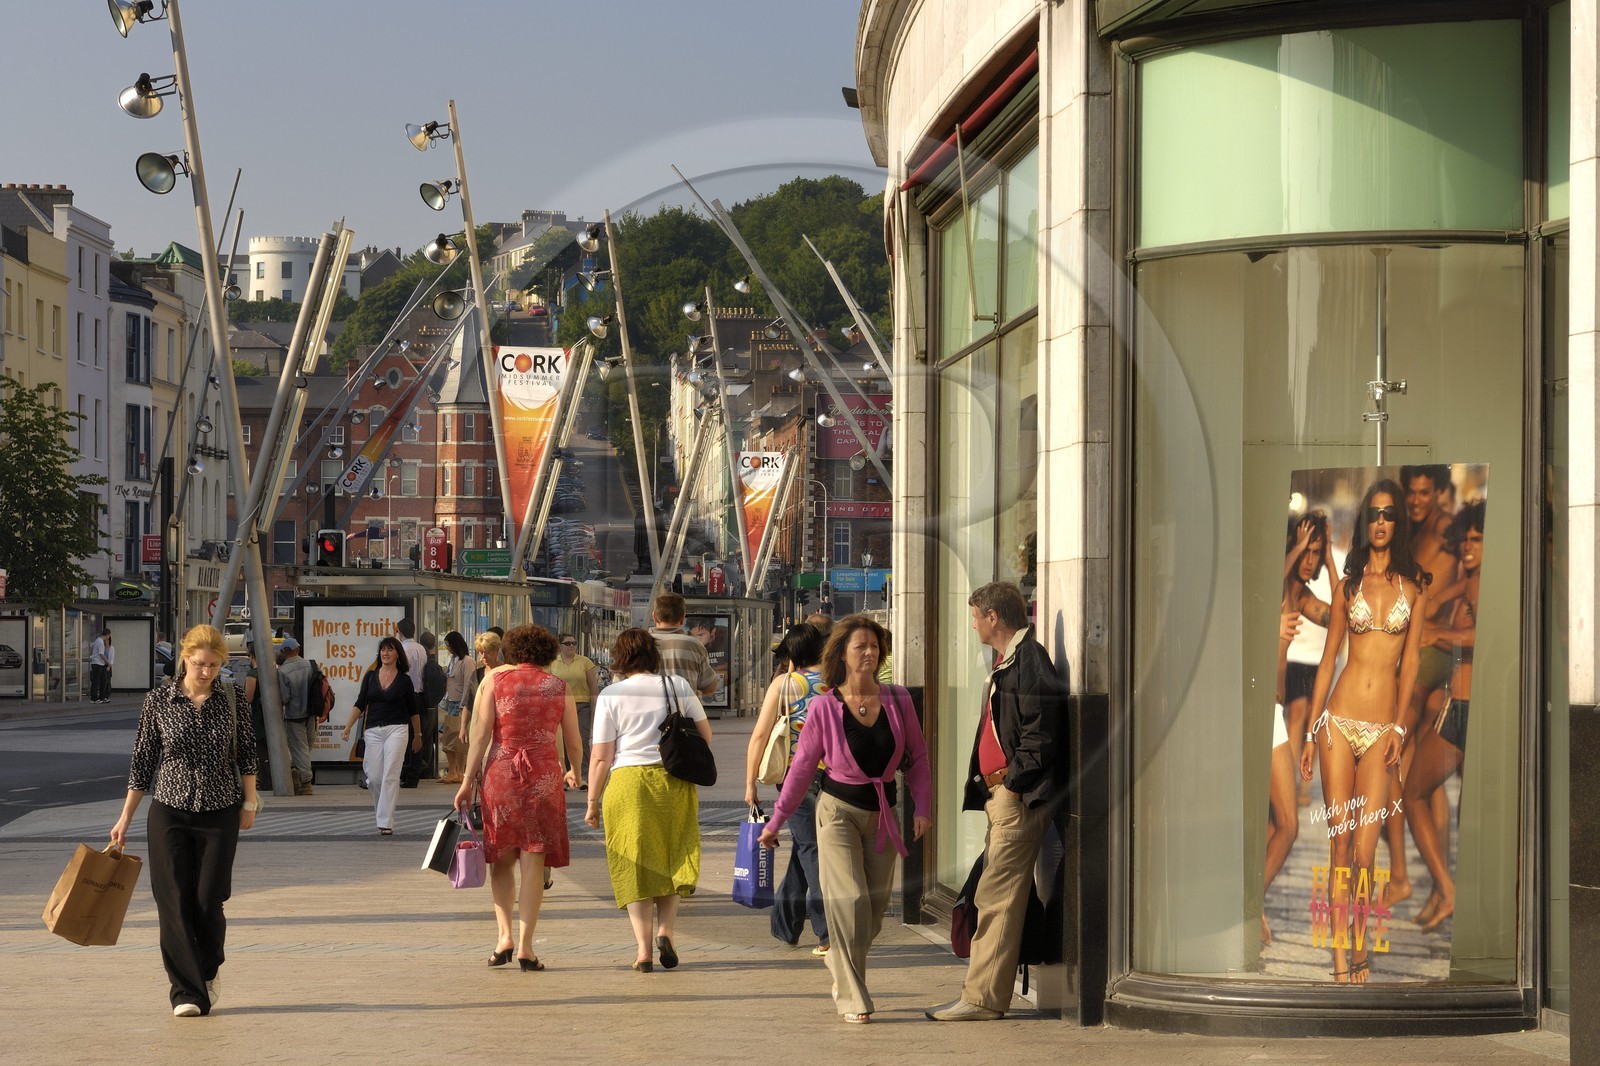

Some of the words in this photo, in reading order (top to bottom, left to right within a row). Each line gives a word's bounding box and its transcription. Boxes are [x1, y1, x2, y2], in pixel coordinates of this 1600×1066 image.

[501, 353, 561, 373] CORK
[741, 456, 780, 468] CORK
[430, 546, 437, 556] 8
[118, 588, 140, 596] schuh
[312, 619, 351, 637] More
[356, 618, 399, 637] fruity
[326, 640, 356, 659] less
[1310, 798, 1342, 825] Wish
[1342, 795, 1368, 823] you
[1327, 820, 1358, 839] were
[1359, 807, 1390, 827] here
[1311, 866, 1391, 910] HEAT
[1309, 903, 1391, 953] WAVE
